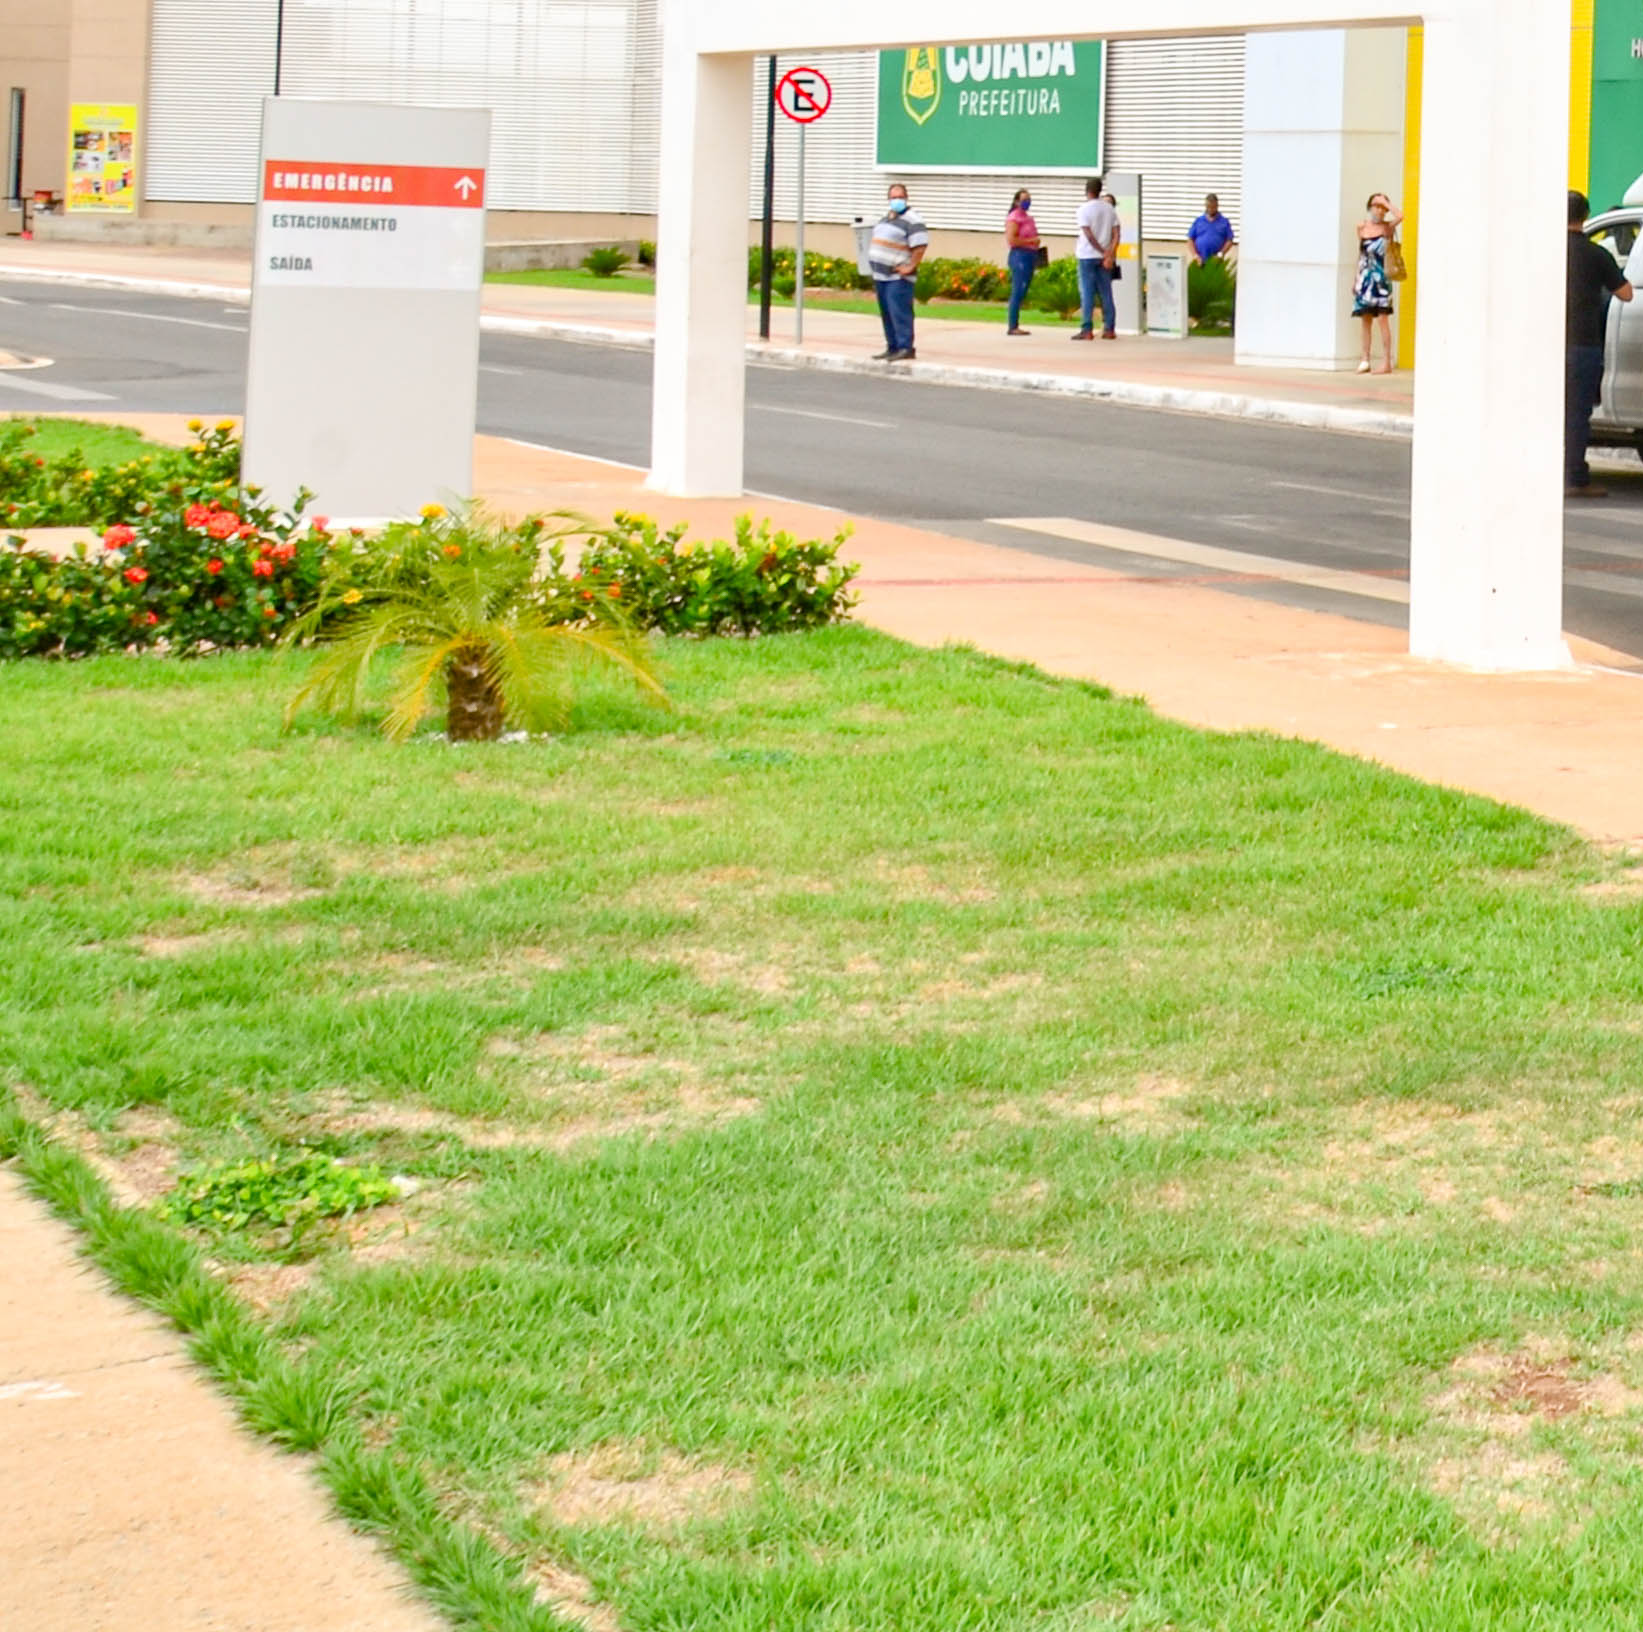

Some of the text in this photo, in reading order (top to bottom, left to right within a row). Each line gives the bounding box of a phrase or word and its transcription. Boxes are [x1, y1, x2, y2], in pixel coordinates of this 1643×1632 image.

[959, 87, 1061, 117] PREFEITURA
[273, 171, 394, 193] EMERGÊNCIA
[272, 214, 398, 232] ESTACIONAMENTO
[270, 256, 313, 271] SAÍDA
